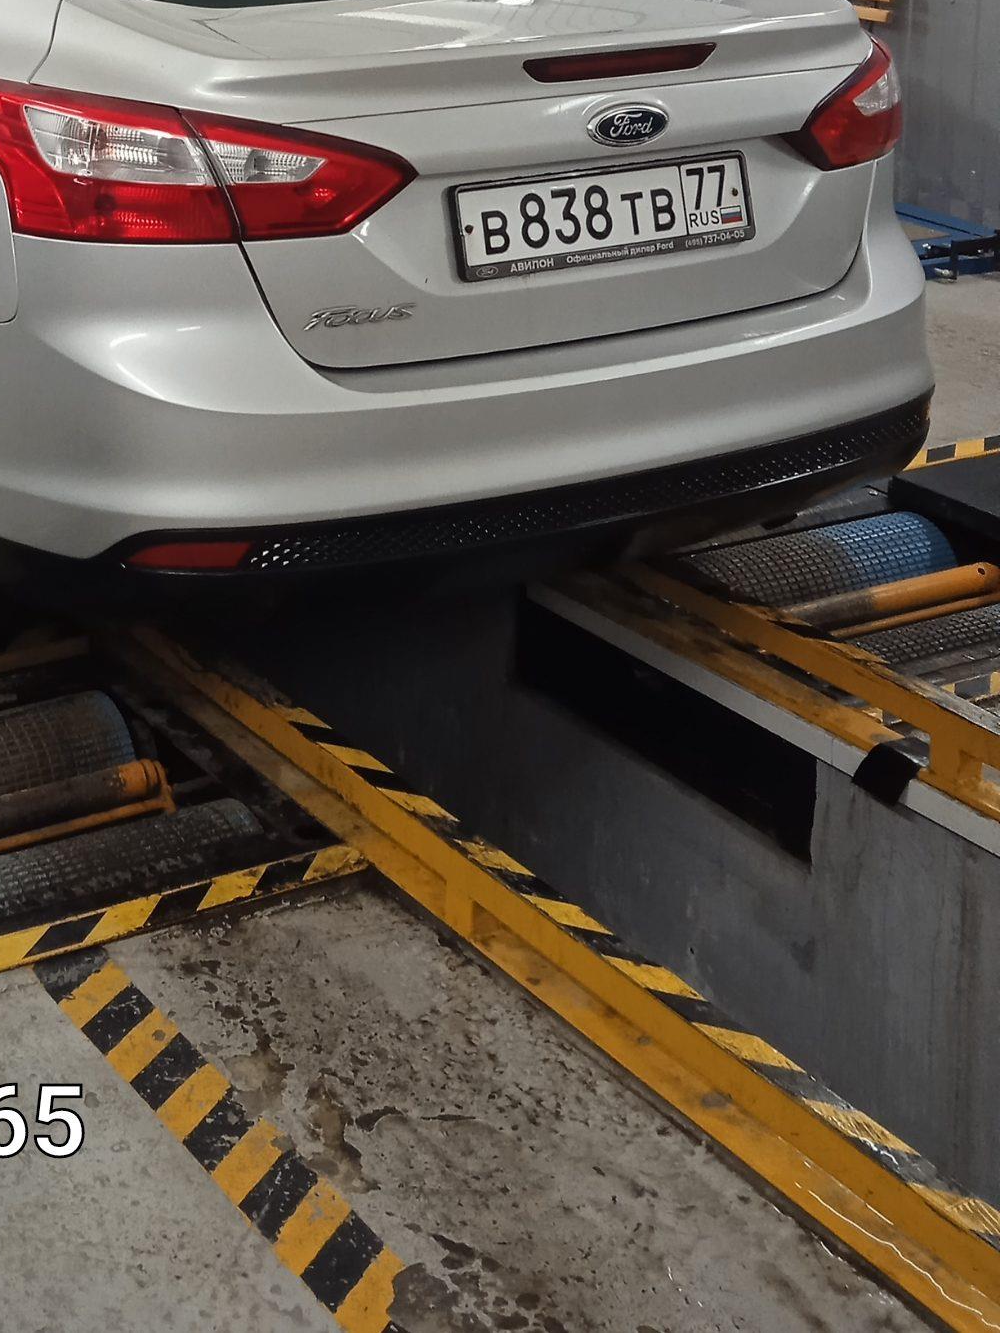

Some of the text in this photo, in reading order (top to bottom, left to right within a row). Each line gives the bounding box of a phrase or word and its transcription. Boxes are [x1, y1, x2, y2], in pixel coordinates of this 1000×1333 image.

[609, 113, 654, 138] Ford
[685, 164, 726, 211] 77
[689, 210, 720, 228] RUS
[510, 257, 555, 273] АВИЛОН
[656, 240, 674, 252] Ford
